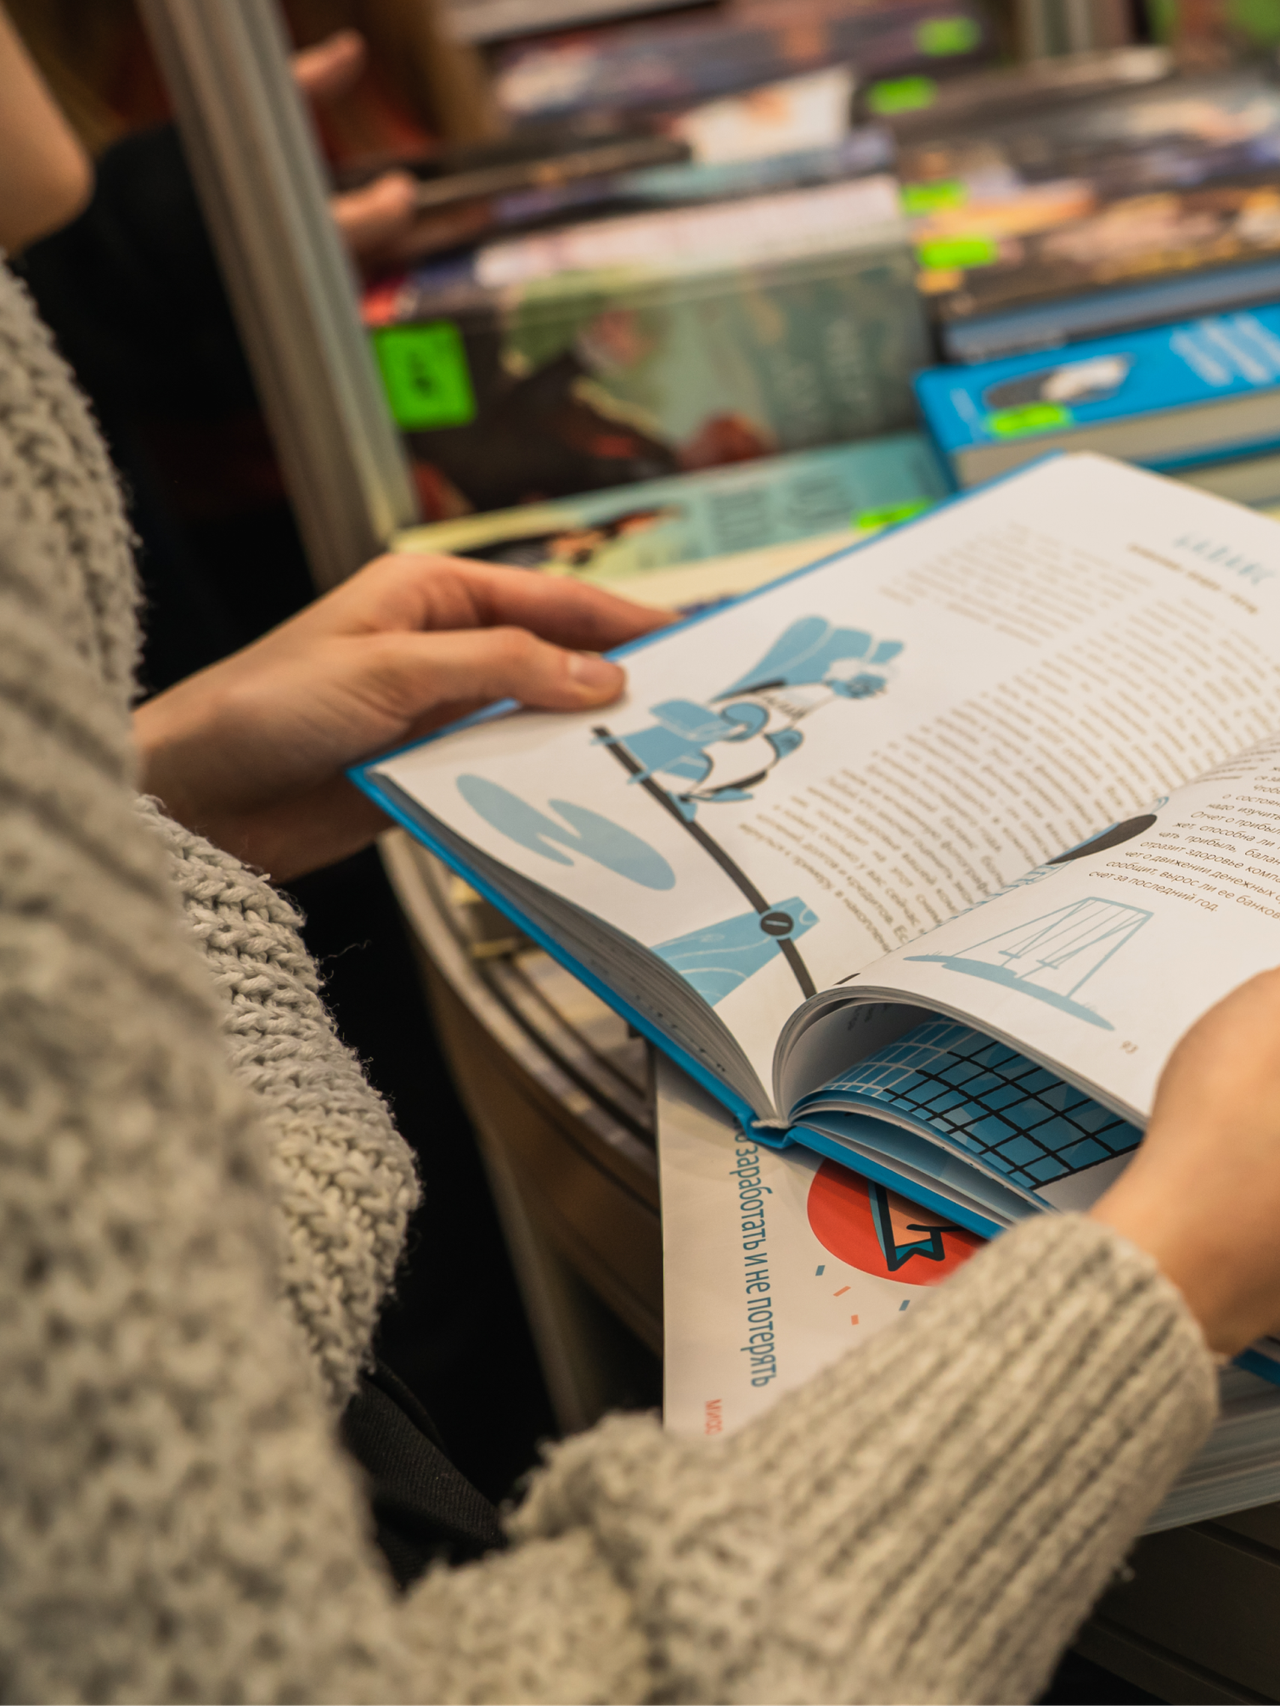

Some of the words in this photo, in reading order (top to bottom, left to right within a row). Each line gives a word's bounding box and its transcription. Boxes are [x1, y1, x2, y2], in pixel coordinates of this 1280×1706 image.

[1190, 811, 1227, 822] Отчет
[1185, 834, 1237, 854] прибыль,
[1200, 825, 1256, 842] способна
[1140, 841, 1186, 853] отразит
[1186, 849, 1245, 870] здоровье
[1106, 860, 1159, 876] сообщит,
[1160, 871, 1199, 888] вырос
[1150, 855, 1213, 876] движении
[1209, 870, 1277, 898] денежных
[1088, 870, 1115, 880] счет
[1129, 877, 1197, 902] последний
[1195, 898, 1219, 913] год.
[729, 1144, 774, 1251] заработать
[744, 1252, 768, 1267] и
[745, 1268, 771, 1295] не
[740, 1296, 777, 1388] потерять
